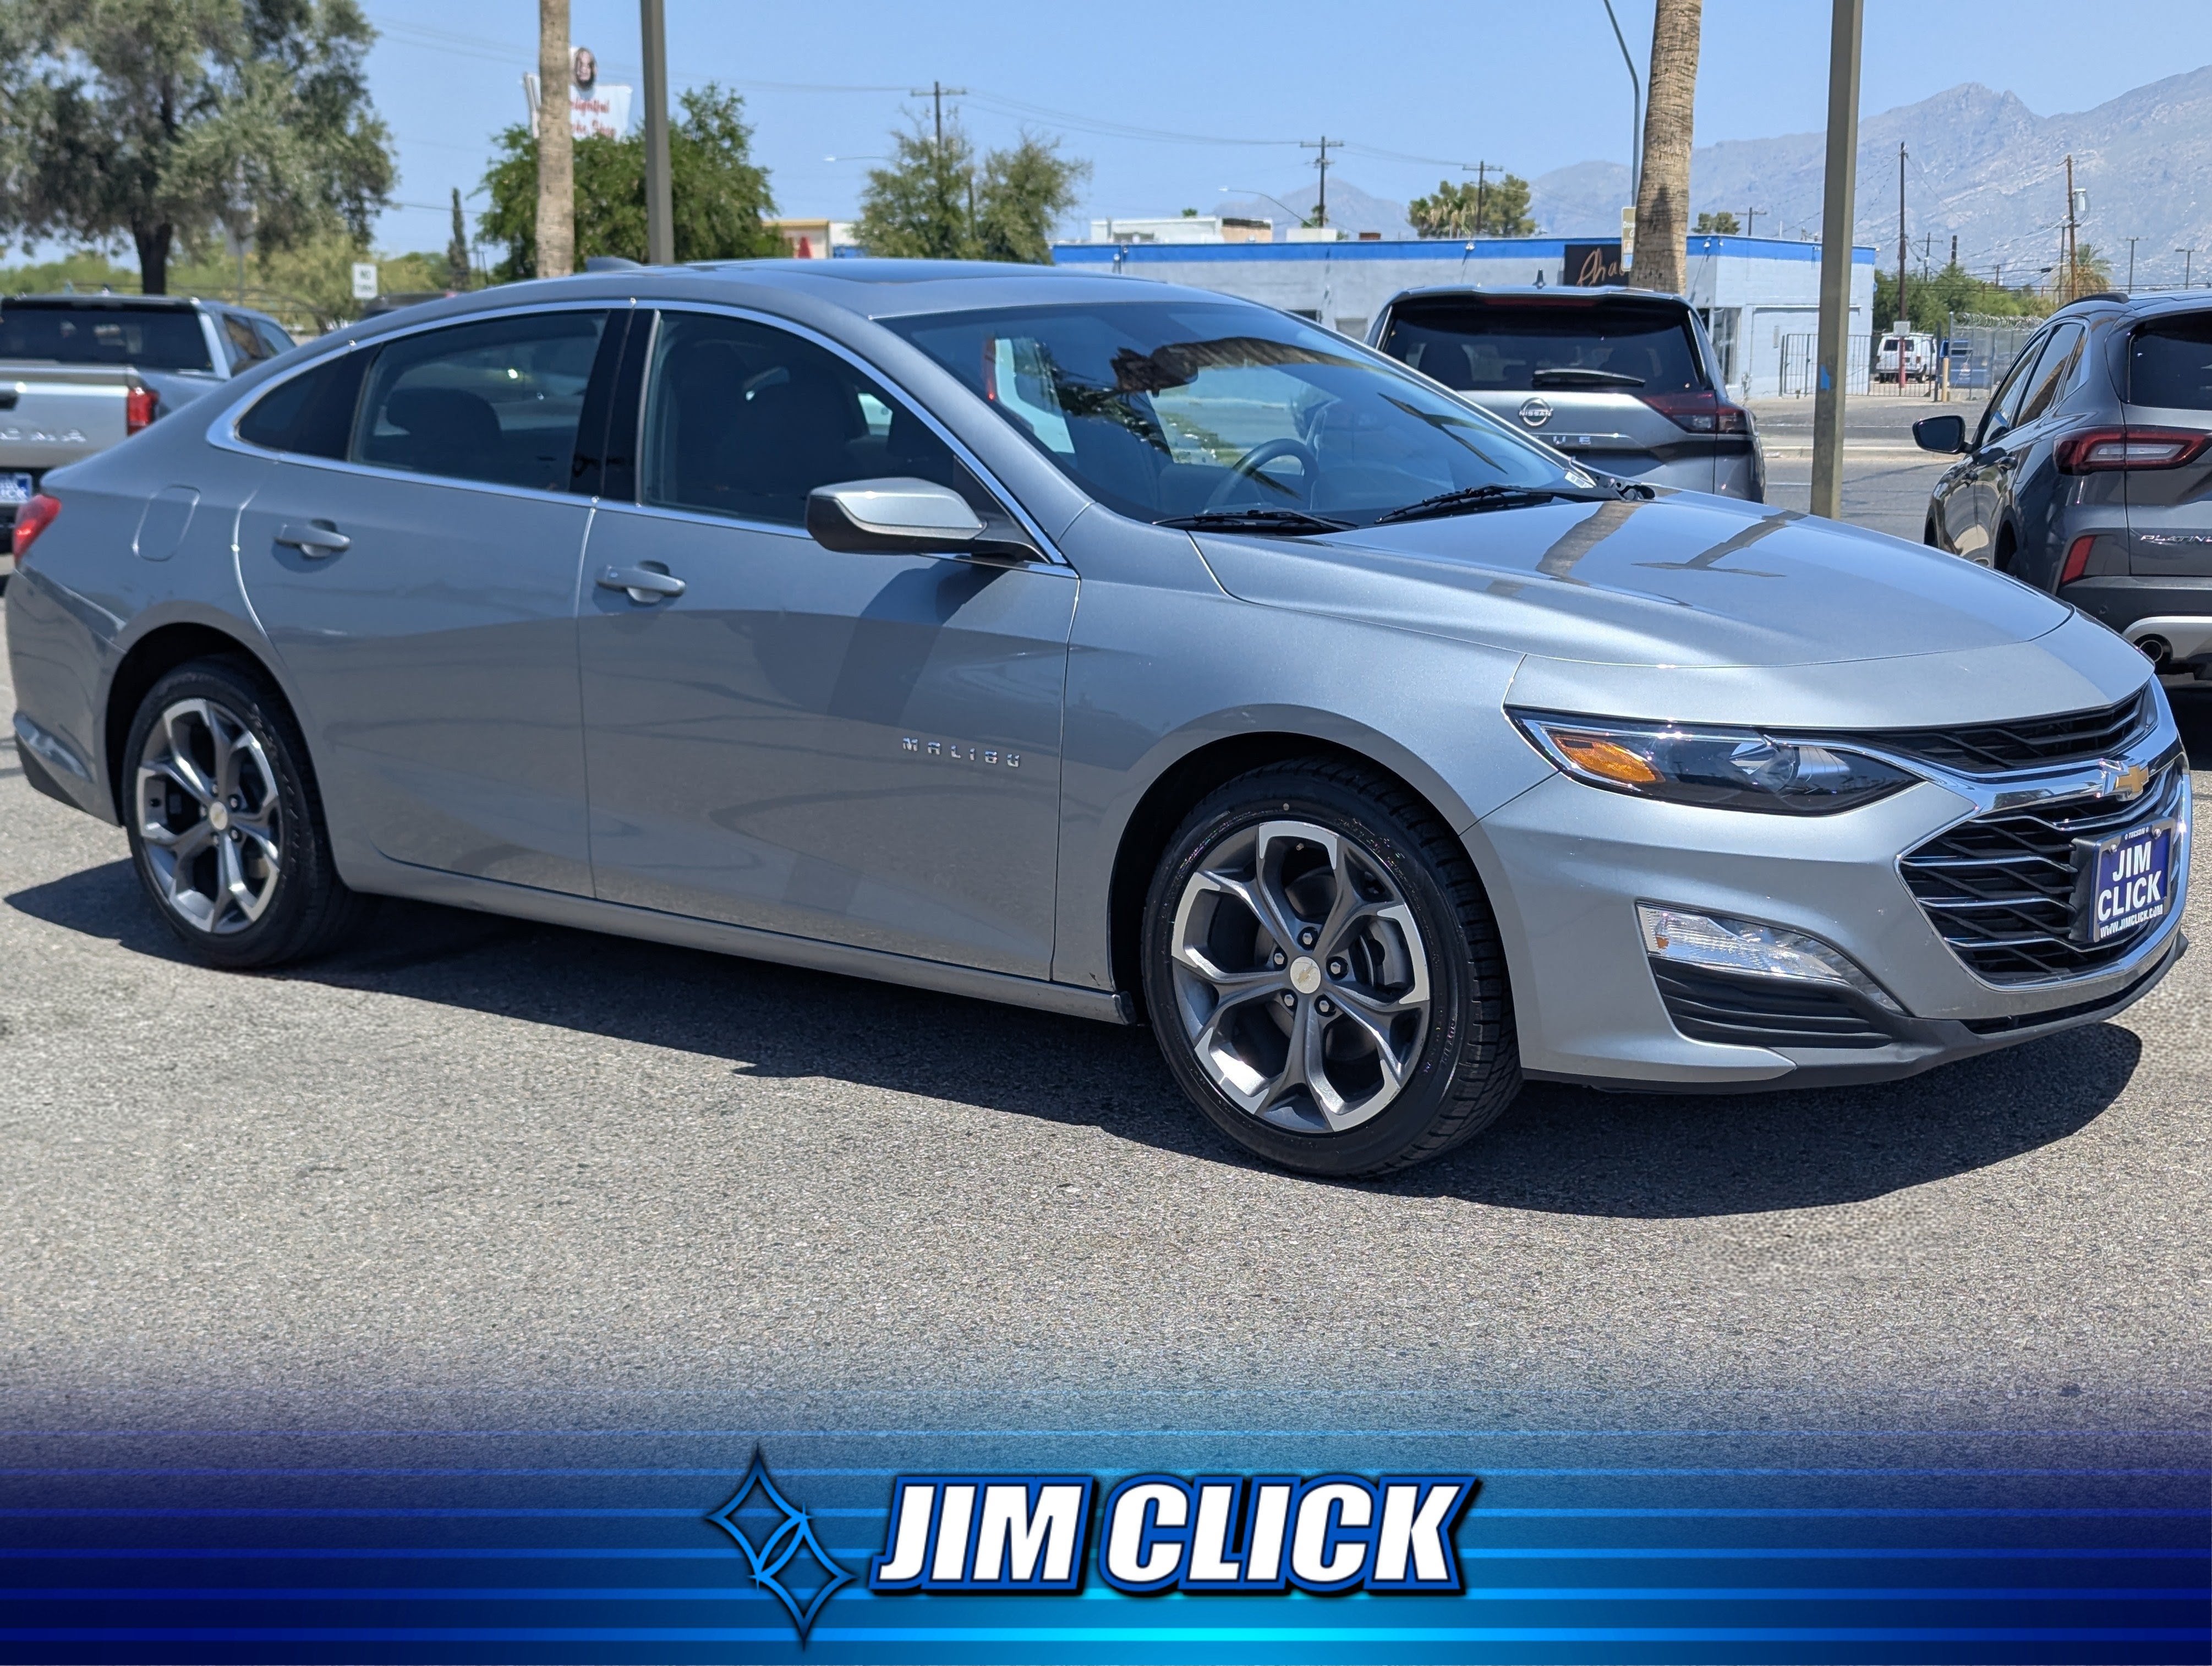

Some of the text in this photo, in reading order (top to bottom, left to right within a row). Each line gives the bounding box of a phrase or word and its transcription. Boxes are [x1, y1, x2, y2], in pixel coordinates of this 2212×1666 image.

[902, 737, 1020, 768] MALIBU
[2112, 841, 2151, 882] JIM
[2098, 870, 2162, 921] CLICK
[2100, 904, 2163, 938] WWW.JIMCLICK.COM
